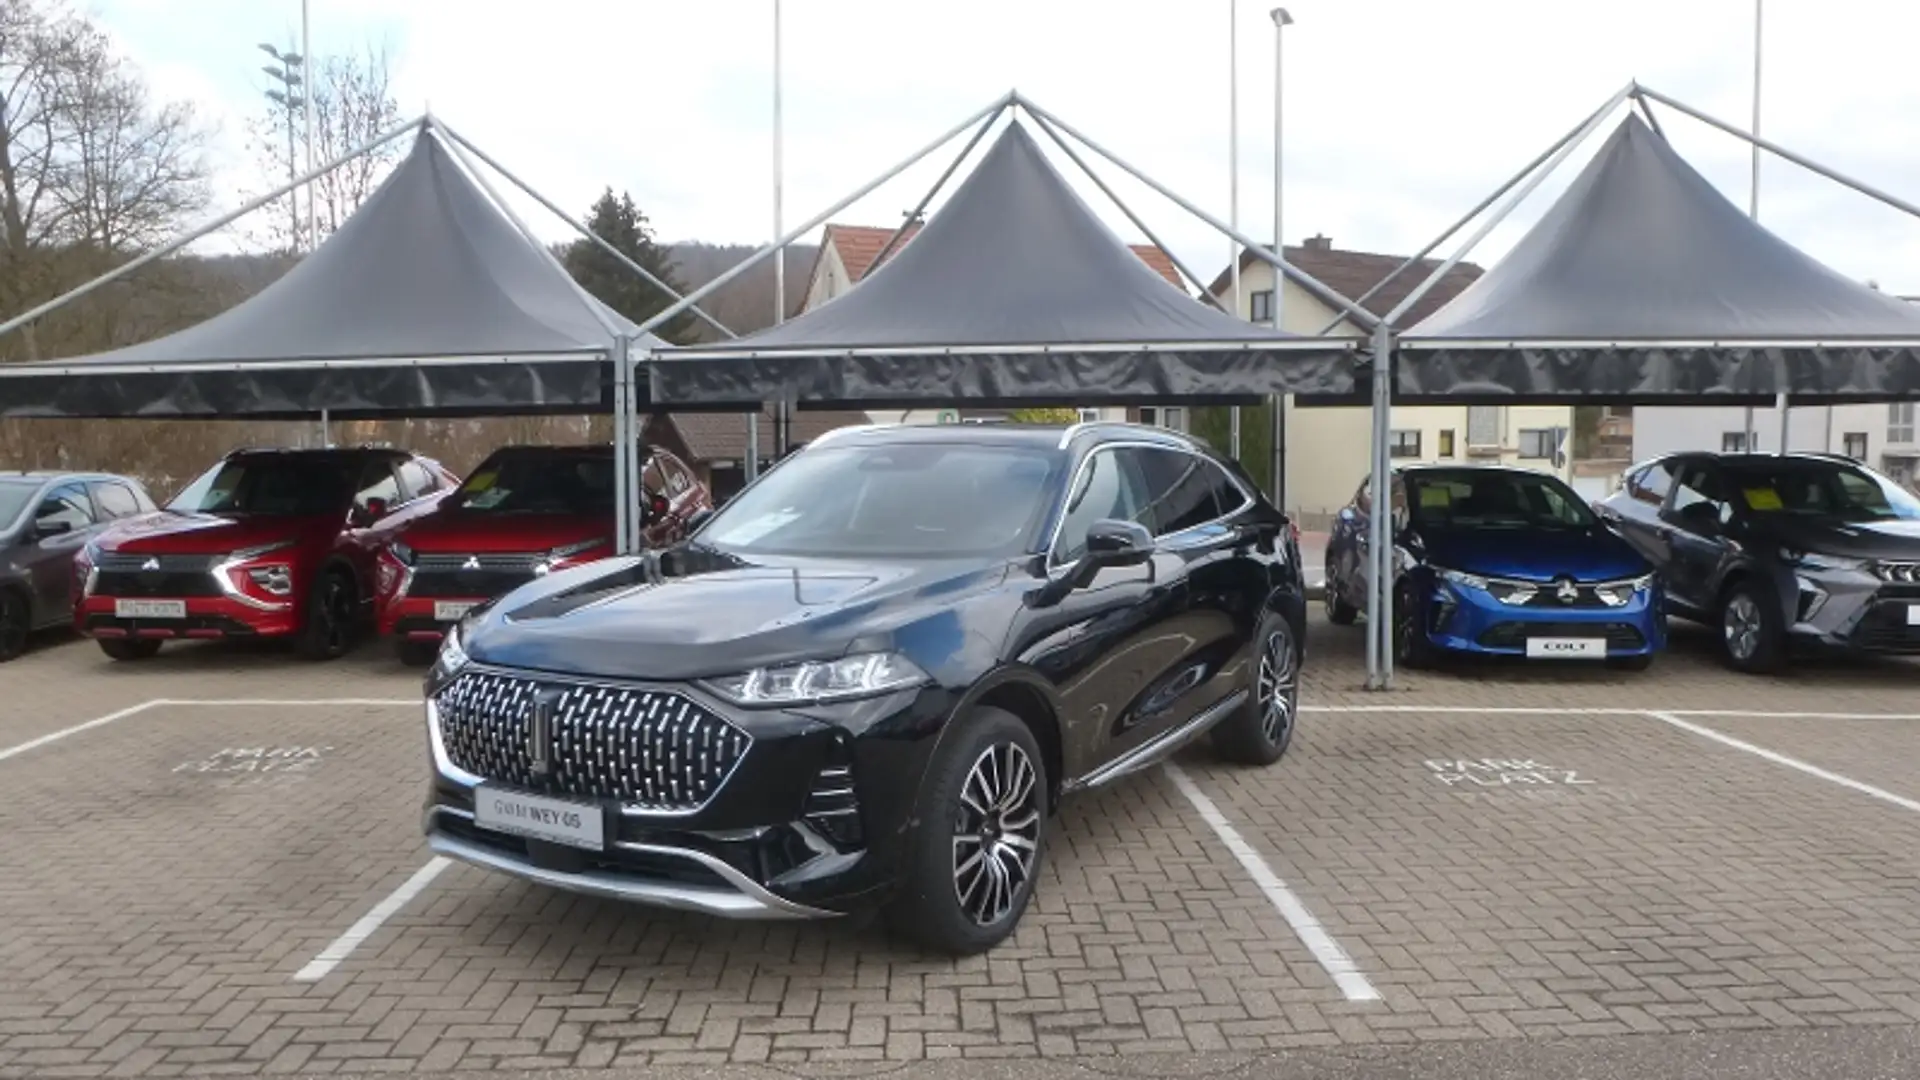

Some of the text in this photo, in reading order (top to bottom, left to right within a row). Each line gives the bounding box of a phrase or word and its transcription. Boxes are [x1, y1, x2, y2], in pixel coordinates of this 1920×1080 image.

[1542, 641, 1588, 652] COLT
[1424, 757, 1553, 771] PARK
[1434, 770, 1597, 786] PLATZ
[530, 805, 561, 825] WEY
